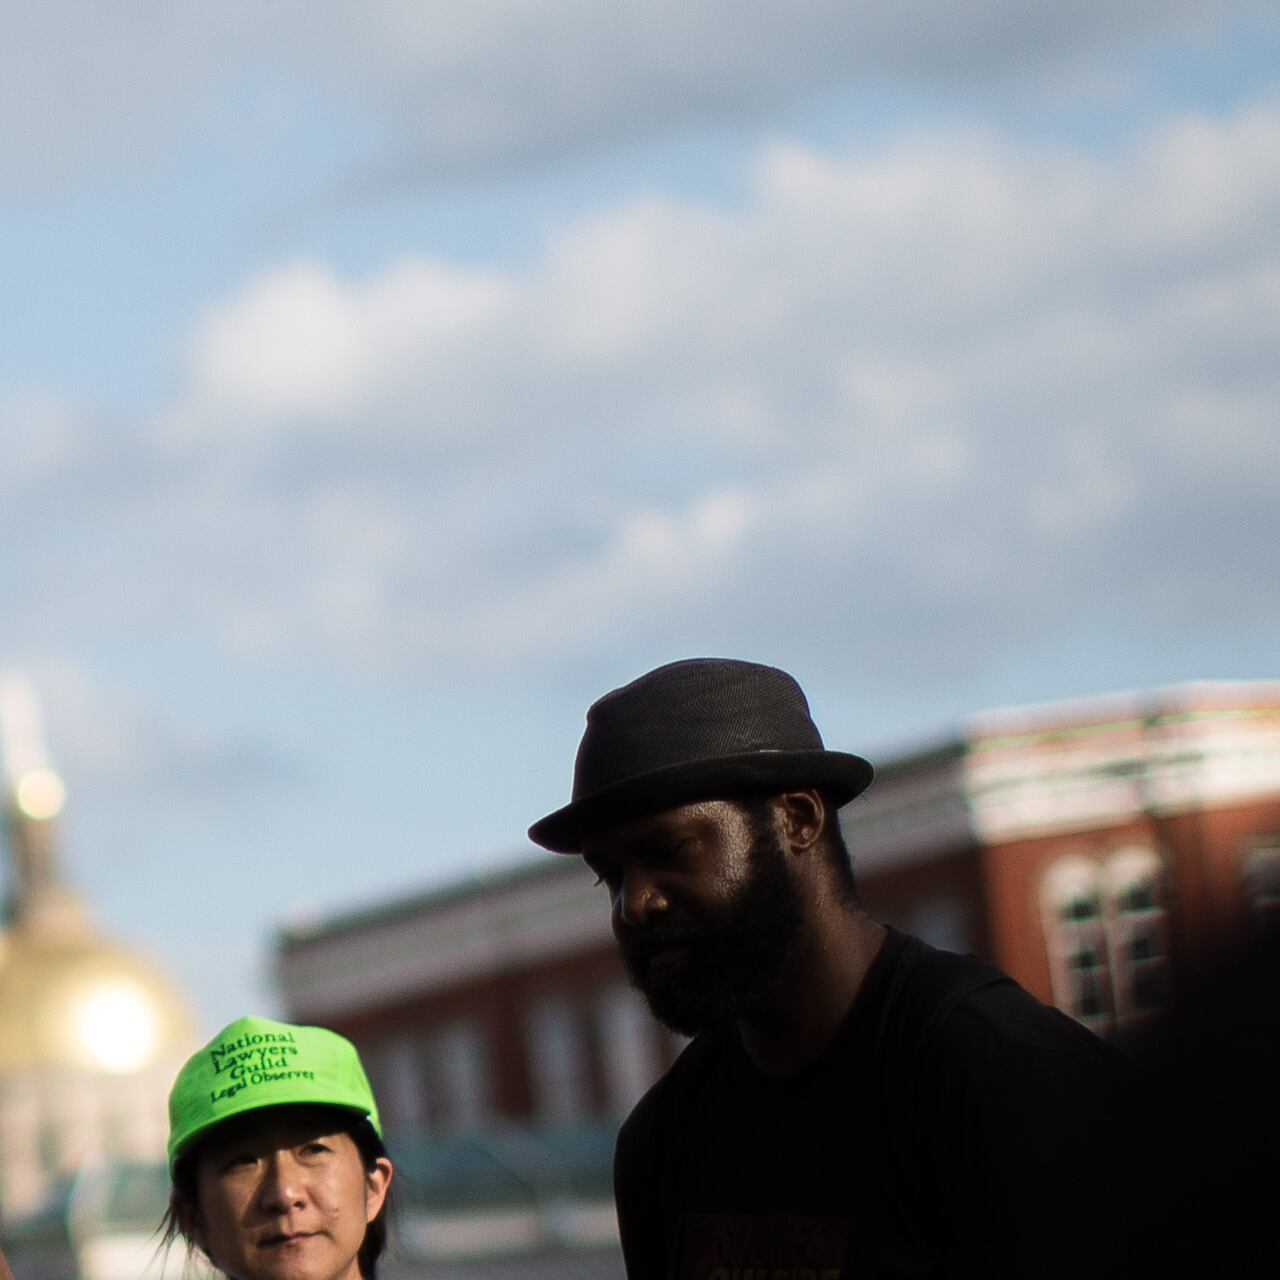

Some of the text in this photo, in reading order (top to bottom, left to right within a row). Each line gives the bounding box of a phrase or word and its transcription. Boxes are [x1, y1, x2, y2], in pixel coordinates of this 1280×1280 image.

[210, 1032, 296, 1061] National
[213, 1046, 298, 1074] Lawyers
[230, 1057, 287, 1079] Guild
[210, 1071, 315, 1103] Legal Observer
